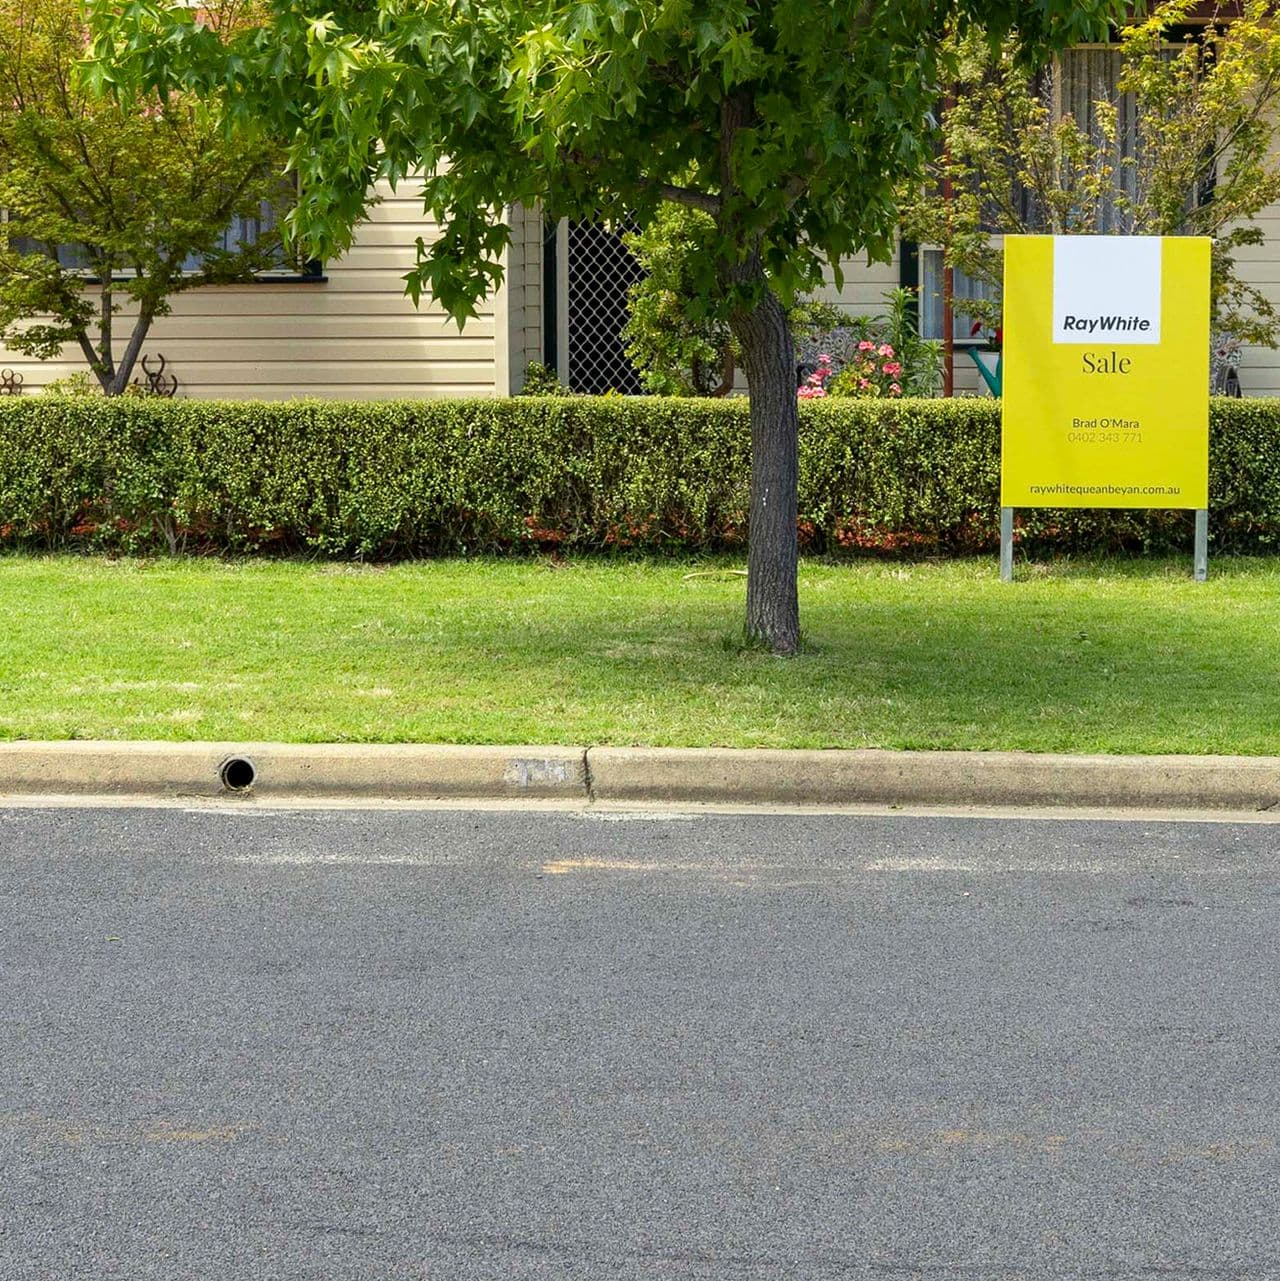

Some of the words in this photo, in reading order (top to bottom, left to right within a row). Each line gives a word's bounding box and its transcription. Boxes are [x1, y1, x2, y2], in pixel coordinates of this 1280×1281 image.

[1063, 315, 1150, 333] RayWhite
[1082, 351, 1131, 374] Sale
[1072, 418, 1097, 428] Brad
[1100, 418, 1139, 428] O'Mara
[1067, 432, 1096, 443] 0402
[1123, 432, 1143, 443] 771
[1030, 483, 1181, 496] raywhitequeanbeyan.com.au
